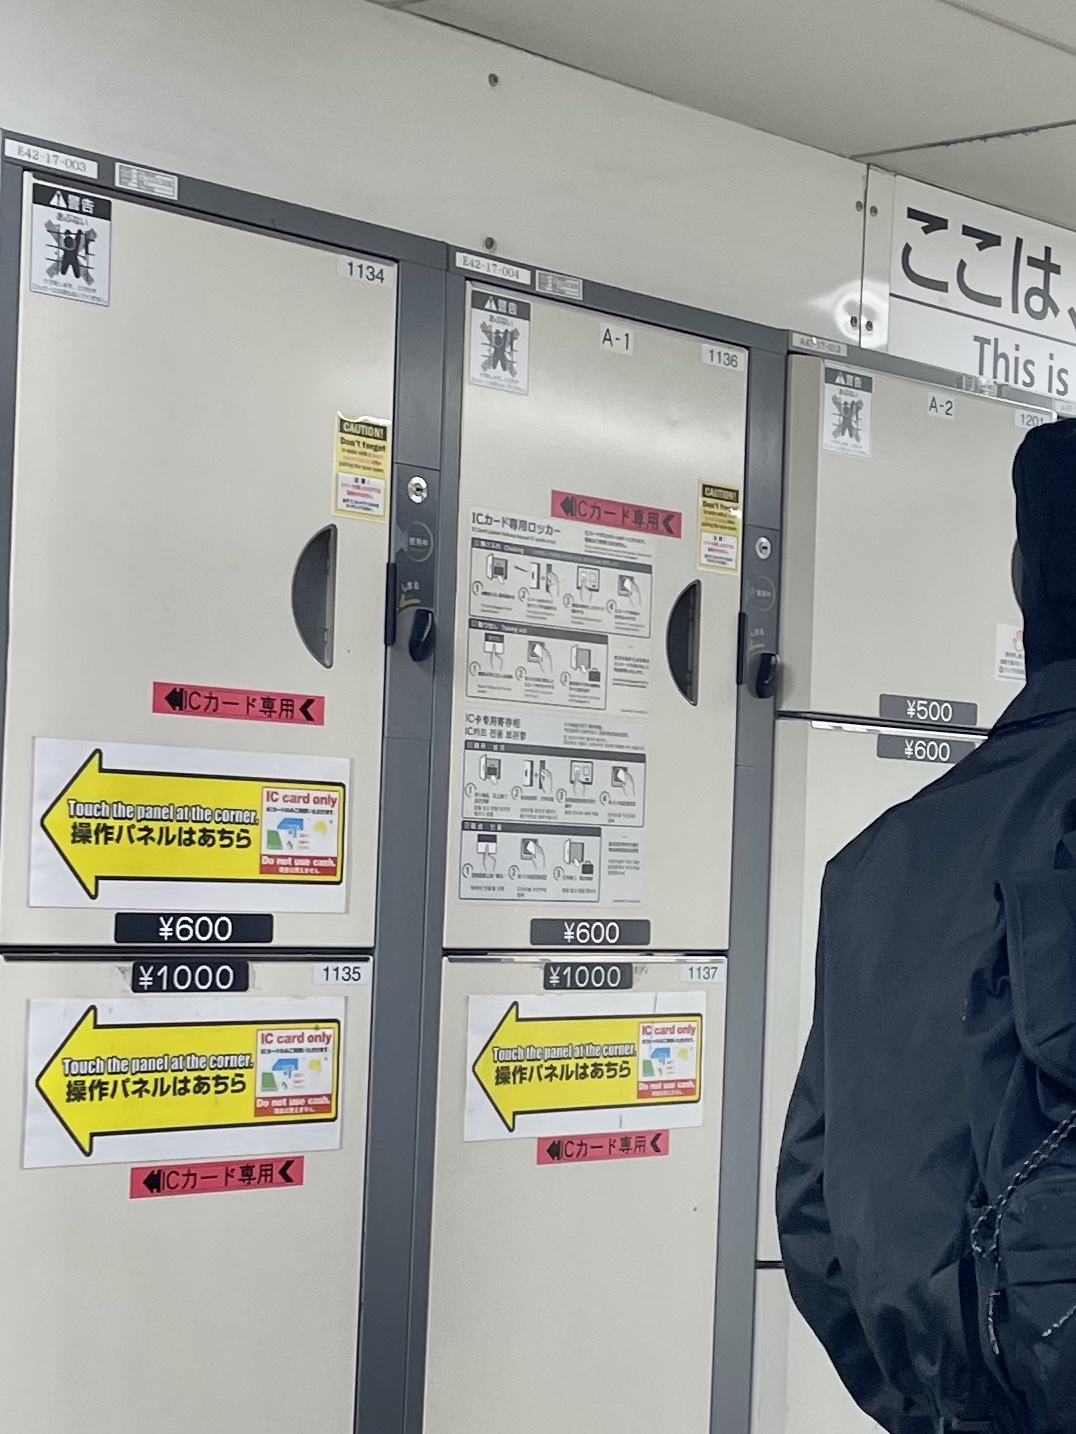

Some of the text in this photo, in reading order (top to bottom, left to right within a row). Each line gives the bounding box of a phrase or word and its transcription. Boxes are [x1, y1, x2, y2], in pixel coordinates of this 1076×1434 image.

[347, 261, 385, 284] 1134
[602, 328, 630, 350] A-1
[708, 349, 739, 368] 1136
[973, 335, 1036, 389] This
[1047, 353, 1070, 397] is
[929, 396, 954, 416] A-2
[343, 422, 384, 439] CAUTION!
[574, 500, 660, 531] ICカード専用
[183, 688, 295, 720] ICカード専用
[906, 700, 953, 722] ¥500
[904, 739, 950, 761] ¥600
[266, 791, 337, 808] IC card only
[68, 800, 259, 825] Touch the panel at the corner.
[70, 822, 252, 849] 操作パネルはあちら
[261, 855, 274, 865] Do
[276, 857, 292, 866] not
[294, 858, 310, 866] use
[159, 915, 232, 942] ¥600
[564, 921, 620, 944] ¥600
[138, 964, 234, 990] ¥1000
[322, 966, 362, 982] 1135
[549, 965, 621, 988] ¥1000
[688, 966, 719, 980] 1137
[261, 1032, 332, 1044] IC card only
[642, 1024, 696, 1036] IC card only
[493, 1043, 636, 1062] Touch the panel at the corner.
[63, 1053, 254, 1076] Touch the panel at the corner.
[494, 1061, 631, 1085] 操作パネルはあちら
[66, 1073, 247, 1102] 操作パネルはあちら
[257, 1099, 269, 1107] Do
[271, 1098, 286, 1106] not
[308, 1096, 330, 1105] cash.
[161, 1163, 273, 1191] ICカード専用
